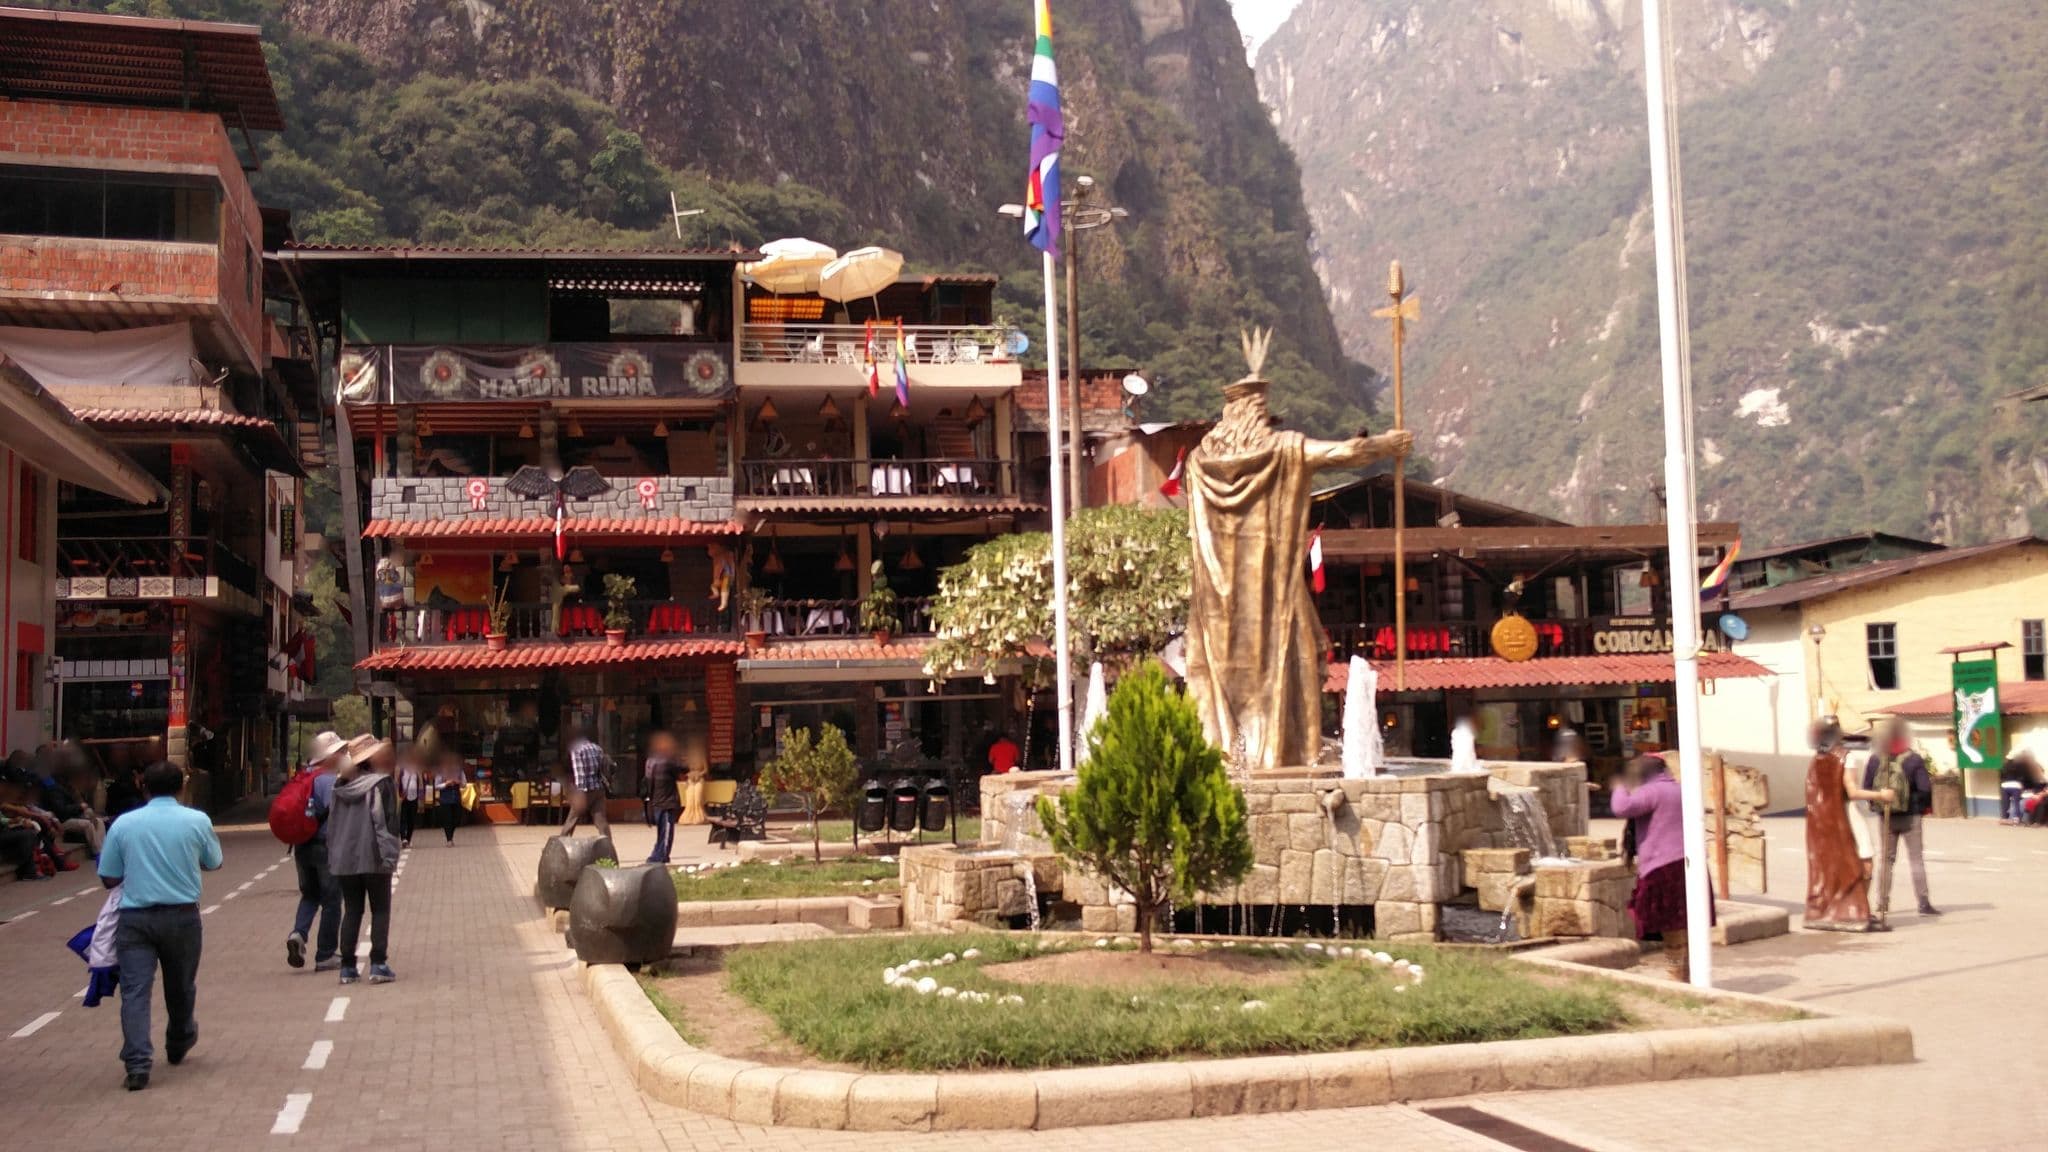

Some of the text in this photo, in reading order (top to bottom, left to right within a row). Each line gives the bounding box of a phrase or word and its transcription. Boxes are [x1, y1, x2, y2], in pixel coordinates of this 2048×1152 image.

[479, 376, 657, 399] HATUN RUNA
[1593, 630, 1718, 653] CORICAA
